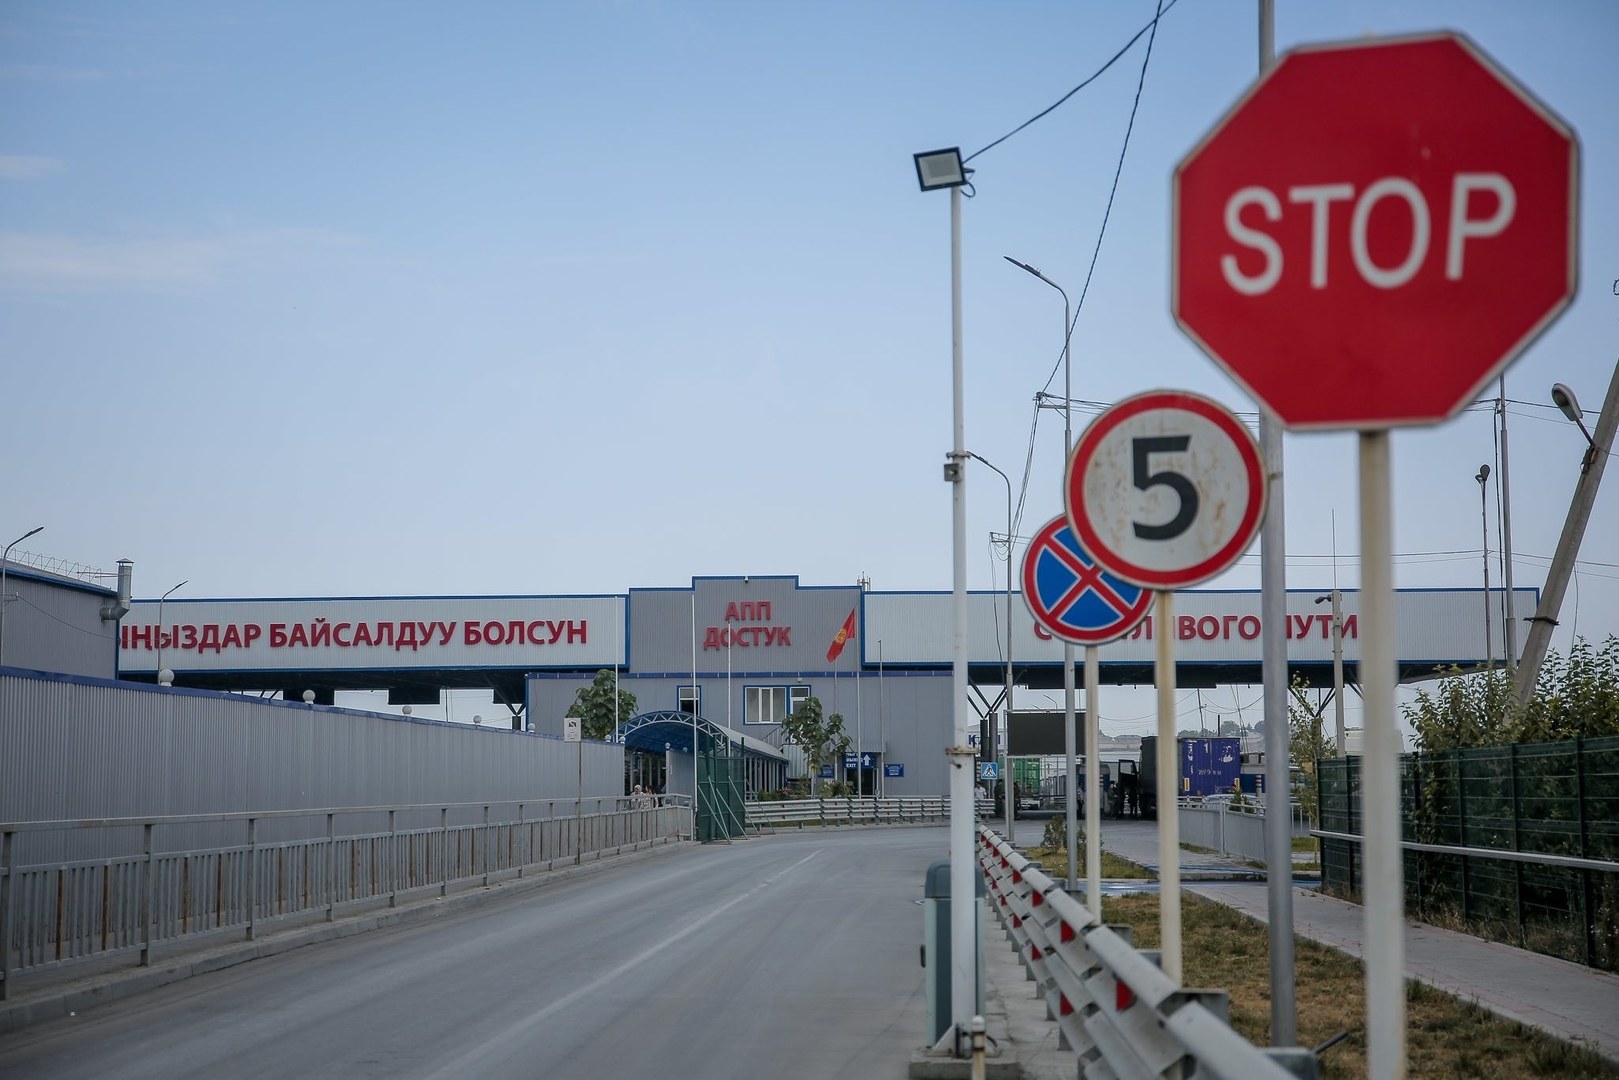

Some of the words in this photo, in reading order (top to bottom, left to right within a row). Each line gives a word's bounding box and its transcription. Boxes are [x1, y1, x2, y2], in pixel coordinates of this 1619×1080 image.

[1221, 172, 1517, 296] STOP
[1131, 434, 1200, 541] 5
[724, 600, 772, 621] АПП
[269, 616, 457, 651] БАЙСАЛДУУ
[464, 619, 588, 646] БОЛСУН
[703, 626, 792, 651] ДОСТУК
